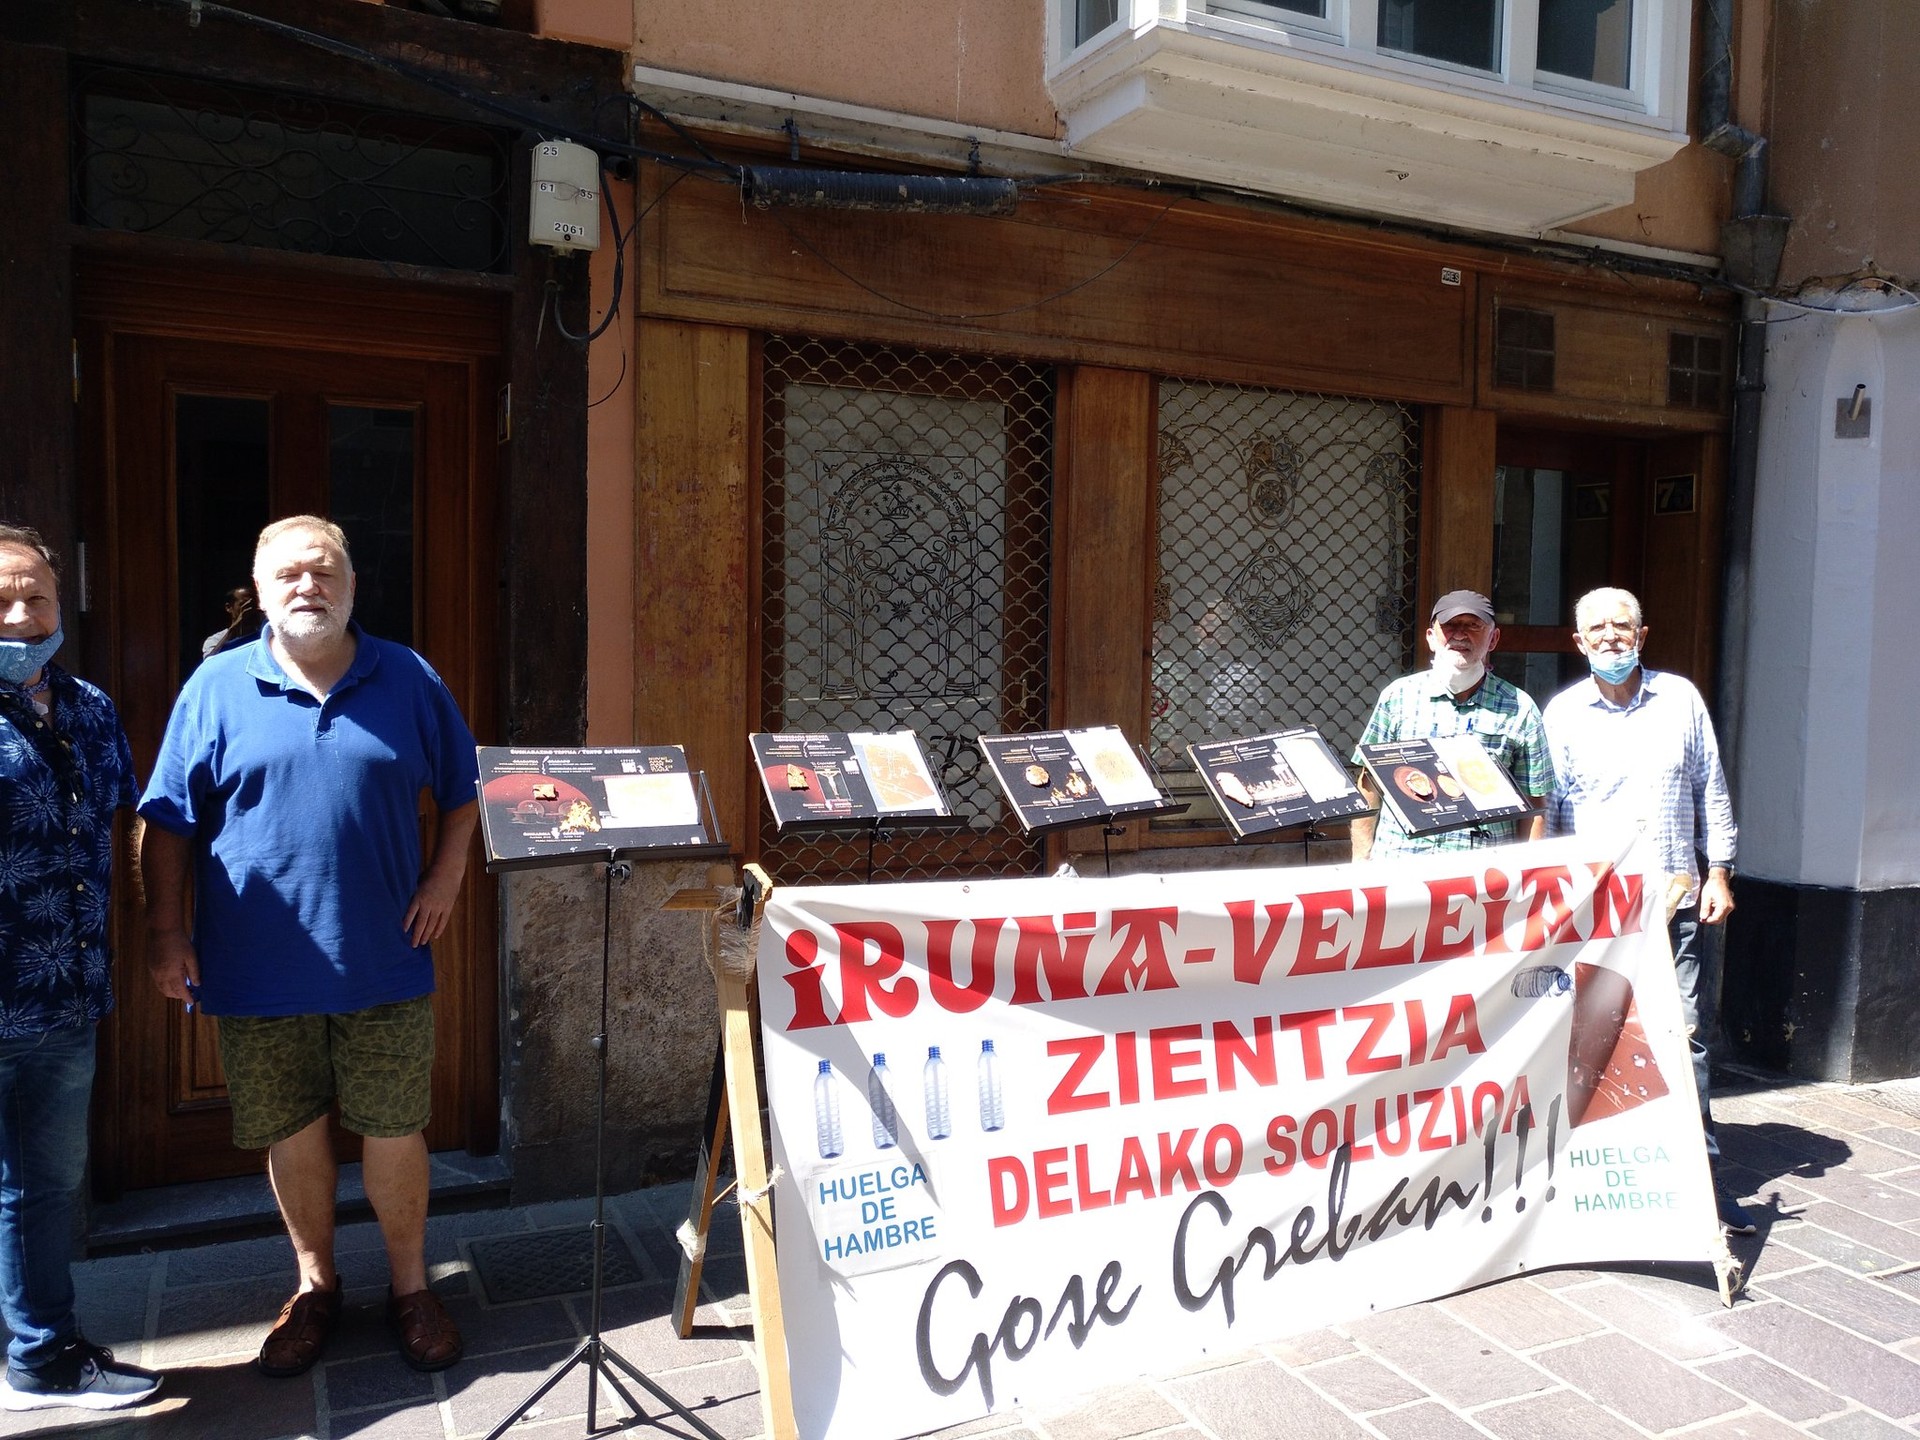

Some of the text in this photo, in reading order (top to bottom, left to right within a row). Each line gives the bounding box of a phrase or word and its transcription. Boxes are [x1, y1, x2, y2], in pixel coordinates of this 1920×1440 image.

[543, 146, 558, 156] 25
[540, 183, 554, 192] 61
[554, 222, 584, 235] 2061
[1047, 993, 1487, 1115] ZIENTZIA
[987, 1073, 1536, 1228] DELAKO SOLUZIOA
[1570, 1144, 1672, 1169] HUELGA
[819, 1162, 929, 1205] HUELGA
[1605, 1168, 1636, 1188] DE
[862, 1196, 897, 1224] DE
[1574, 1190, 1680, 1213] HAMBRE
[824, 1216, 937, 1261] HAMBRE
[916, 1259, 1142, 1414] Gose
